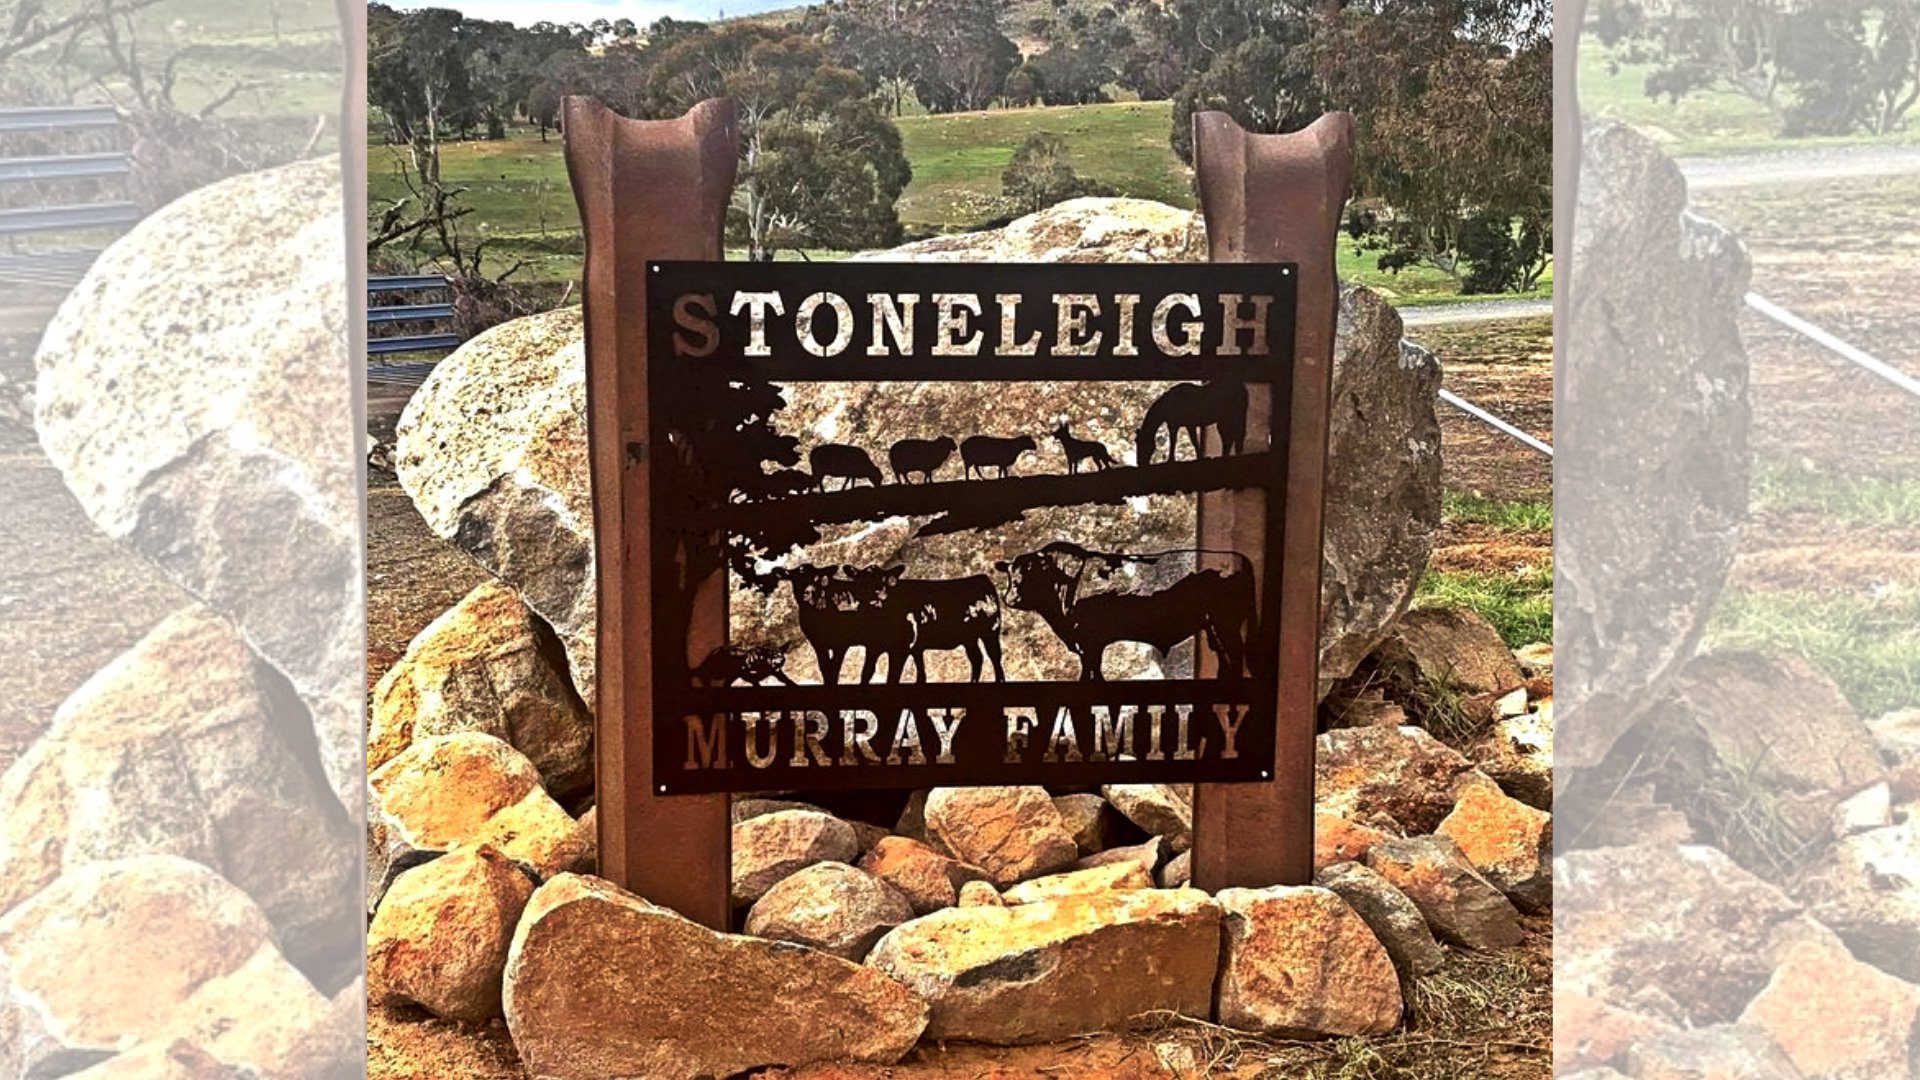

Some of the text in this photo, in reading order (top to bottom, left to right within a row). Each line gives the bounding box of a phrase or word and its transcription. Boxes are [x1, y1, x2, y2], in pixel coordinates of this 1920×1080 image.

[672, 290, 1274, 357] STONELEIGH
[683, 703, 1251, 770] MURRAY FAMILY
